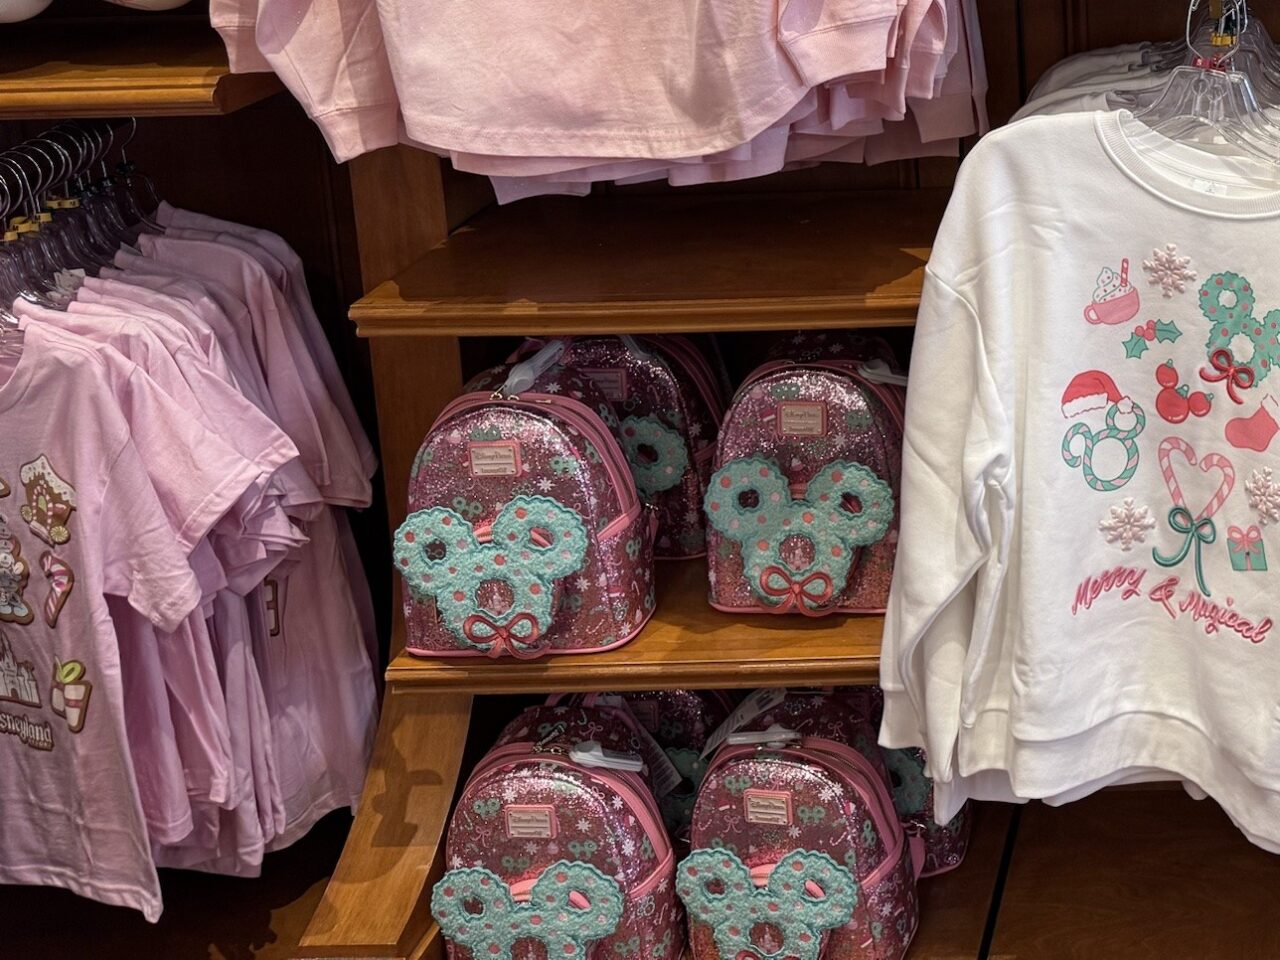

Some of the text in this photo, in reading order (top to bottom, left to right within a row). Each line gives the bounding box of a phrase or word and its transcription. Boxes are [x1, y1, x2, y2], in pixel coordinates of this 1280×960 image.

[1072, 566, 1274, 644] Merry & Magical
